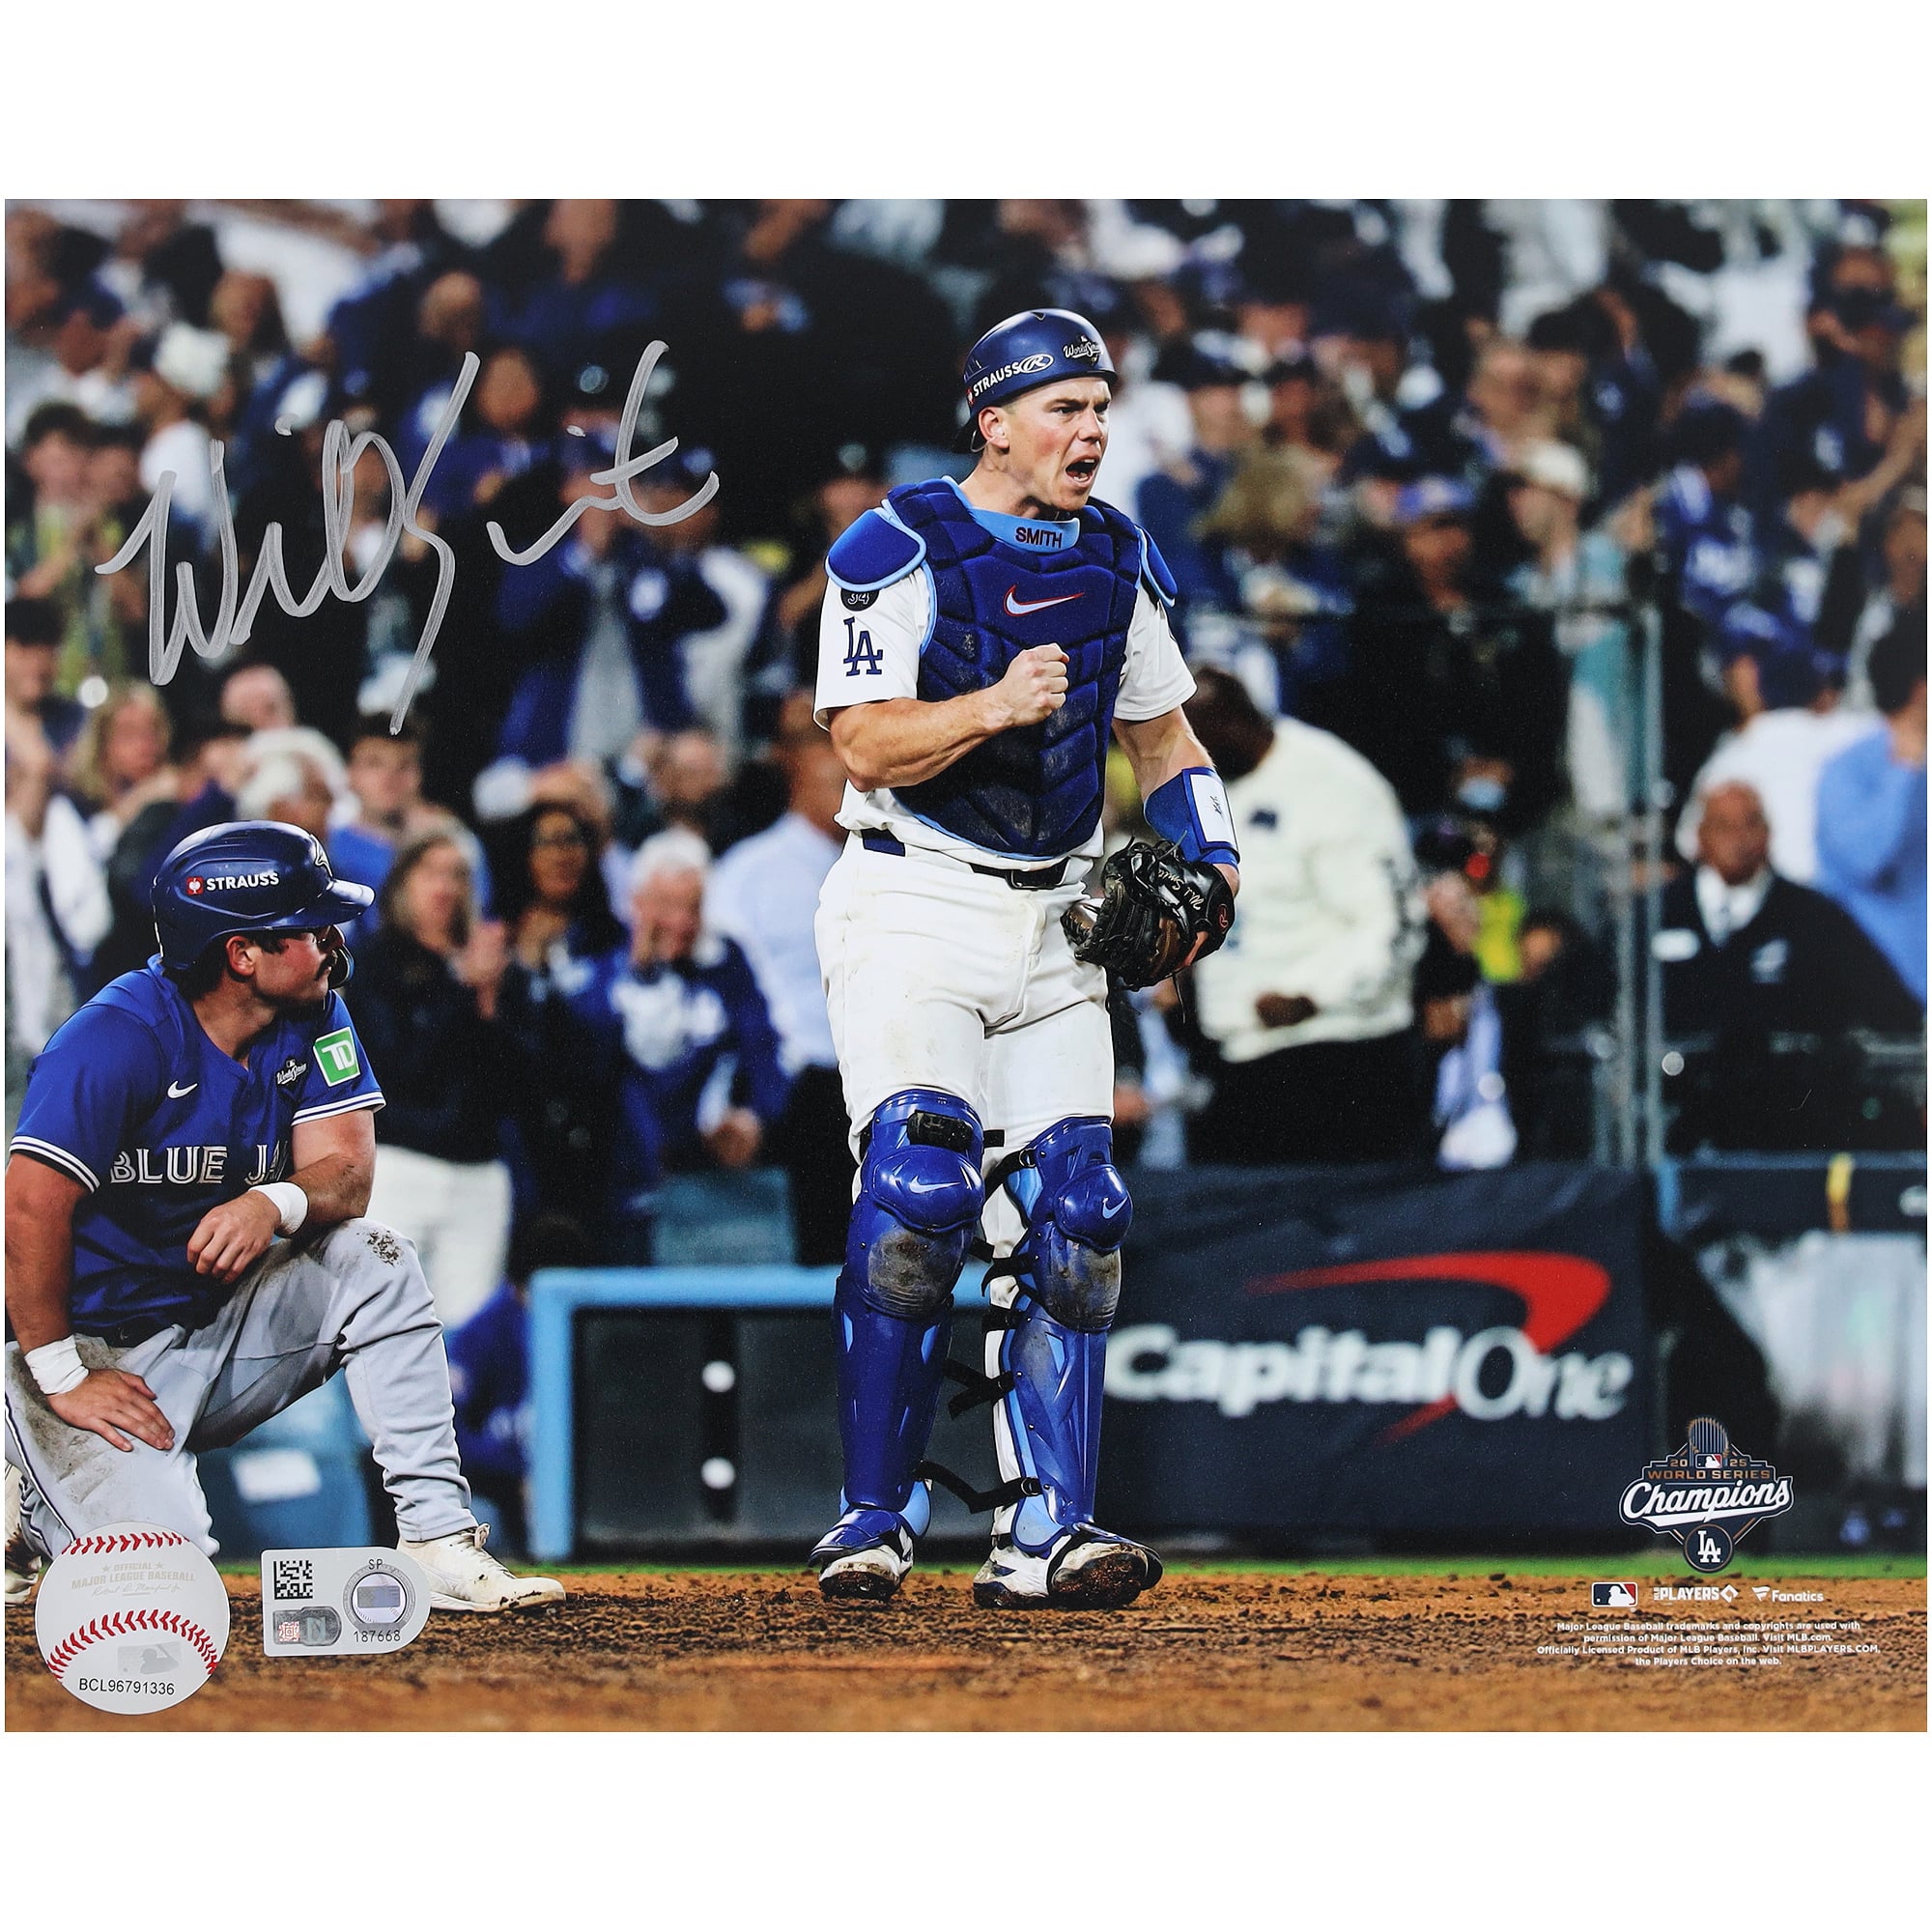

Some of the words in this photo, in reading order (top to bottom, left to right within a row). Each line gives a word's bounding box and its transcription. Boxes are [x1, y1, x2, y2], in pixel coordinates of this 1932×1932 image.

[973, 361, 1021, 397] STRAUSS
[1015, 526, 1063, 550] SMITH
[843, 616, 883, 677] LA
[206, 869, 280, 892] STRAUSS
[321, 1039, 355, 1071] TD
[110, 1146, 228, 1184] BLUE
[113, 1562, 154, 1572] OFFICIAL
[367, 1558, 384, 1571] SP
[71, 1575, 106, 1589] MAJOR
[109, 1571, 145, 1583] LEAGUE
[148, 1571, 196, 1582] BASEBALL
[353, 1630, 401, 1643] 187668
[78, 1678, 176, 1695] BCL96791336
